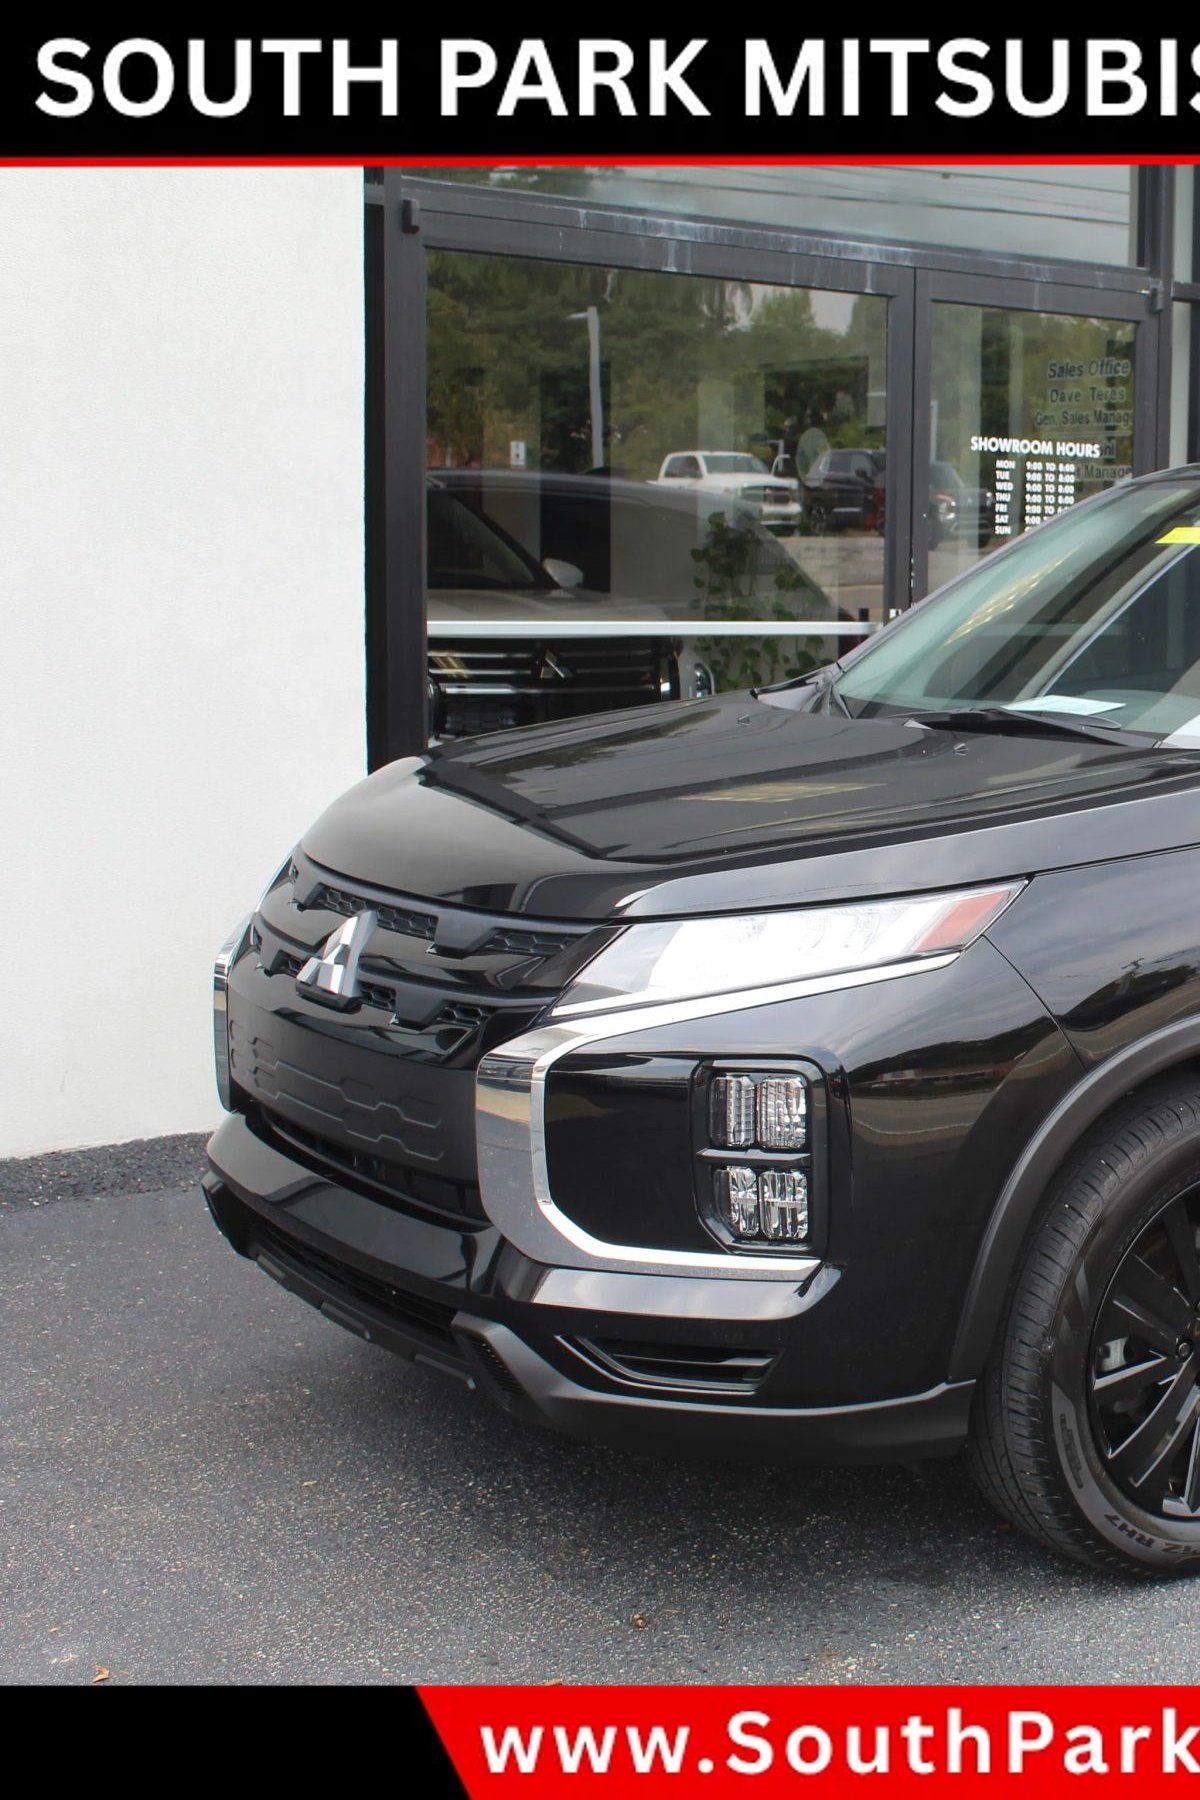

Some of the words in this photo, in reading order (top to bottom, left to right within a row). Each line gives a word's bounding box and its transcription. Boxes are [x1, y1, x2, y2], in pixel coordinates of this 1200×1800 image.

[1048, 363, 1084, 379] Sales
[1088, 359, 1130, 376] Office
[970, 436, 1053, 456] SHOWROOM
[1056, 441, 1100, 458] HOURS
[996, 460, 1015, 469] MON
[1026, 462, 1042, 470] 9:00
[1046, 463, 1056, 471] TO
[996, 471, 1009, 479] TUE
[1026, 473, 1042, 481] 9:00
[1045, 473, 1055, 482] TO
[996, 482, 1013, 490] WED
[1026, 483, 1042, 492] 9:00
[1045, 484, 1055, 493] TO
[996, 493, 1011, 501] THU
[1026, 494, 1042, 503] 9:00
[1045, 495, 1055, 503] TO
[995, 504, 1007, 512] FRI
[1045, 506, 1055, 514] TO
[995, 515, 1009, 523] SAT
[995, 526, 1011, 534] SUN
